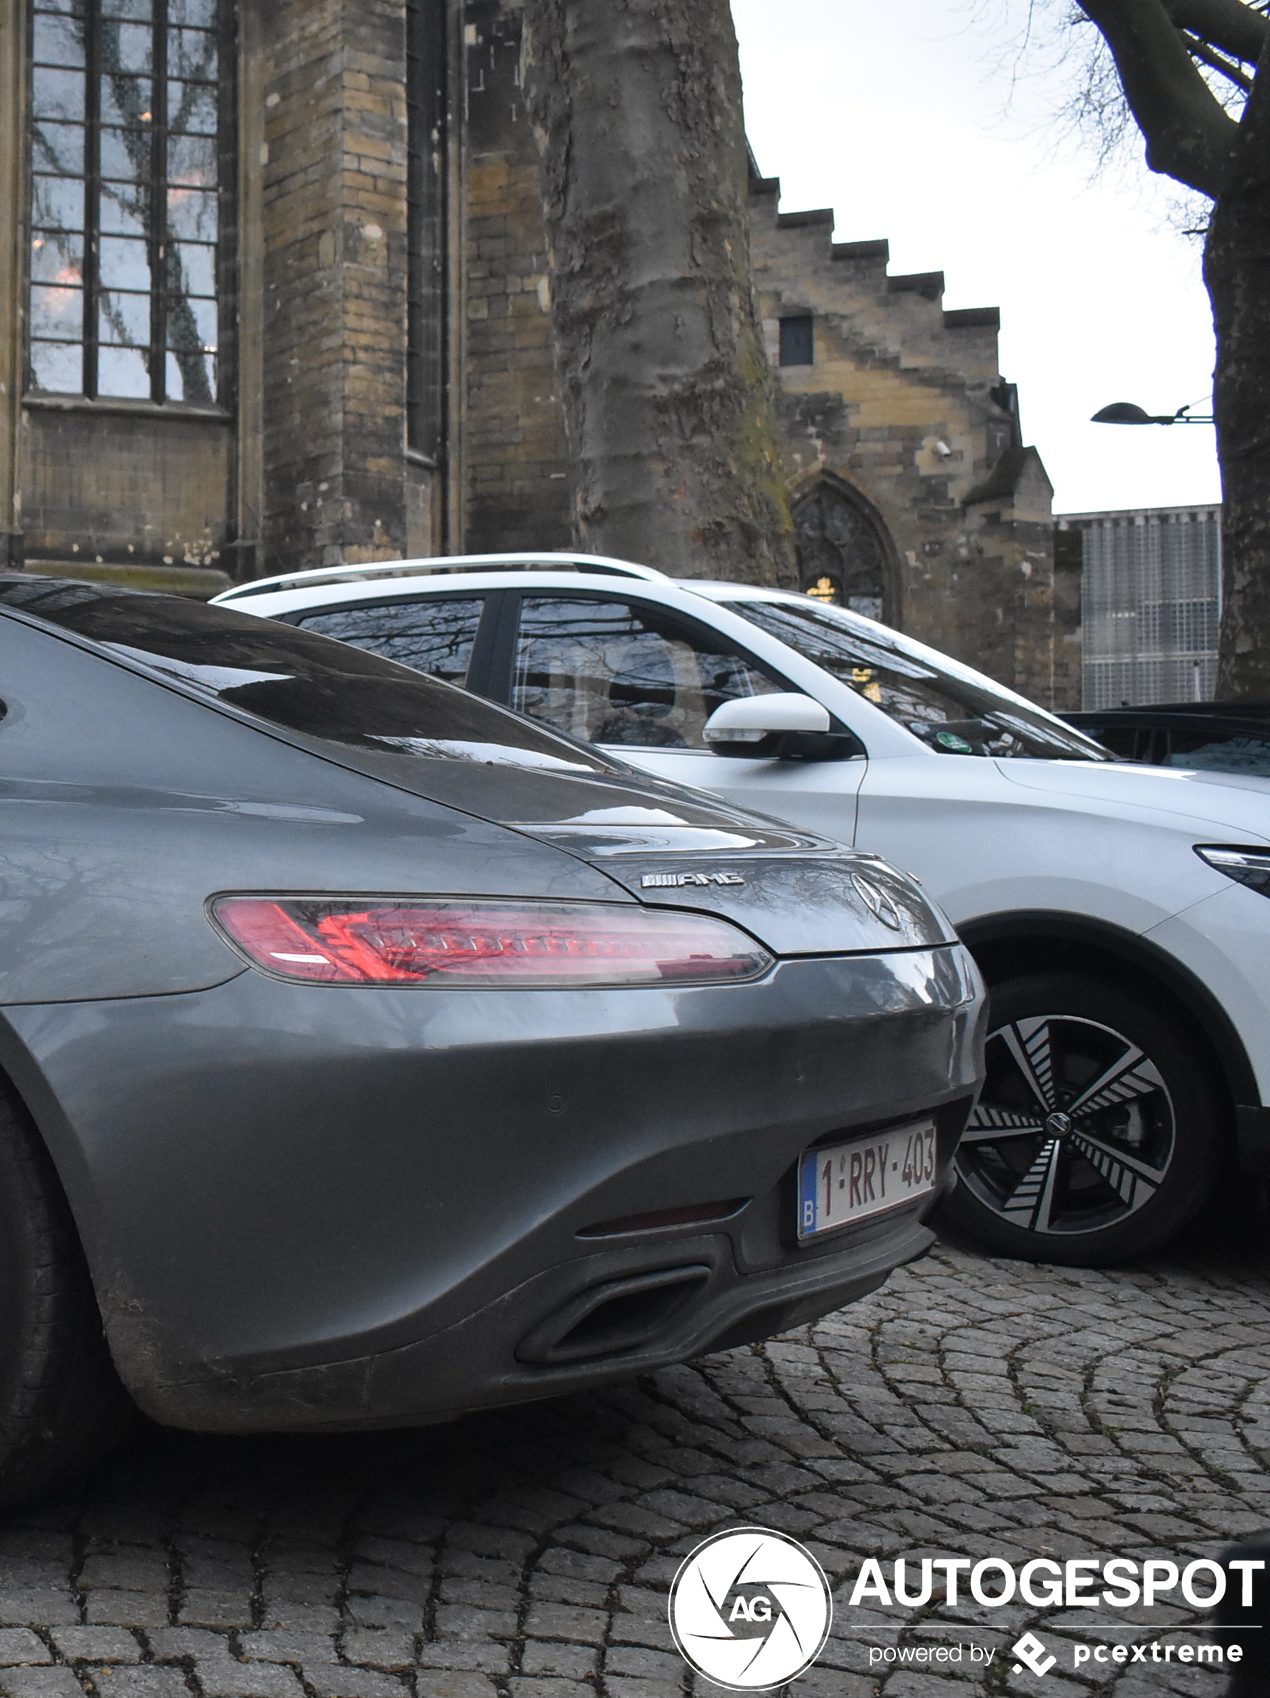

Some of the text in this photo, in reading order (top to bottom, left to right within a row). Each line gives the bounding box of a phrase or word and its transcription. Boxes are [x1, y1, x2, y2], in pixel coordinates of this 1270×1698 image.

[675, 872, 745, 886] AMG
[822, 1127, 934, 1217] 1-RRY-403
[804, 1201, 813, 1226] B
